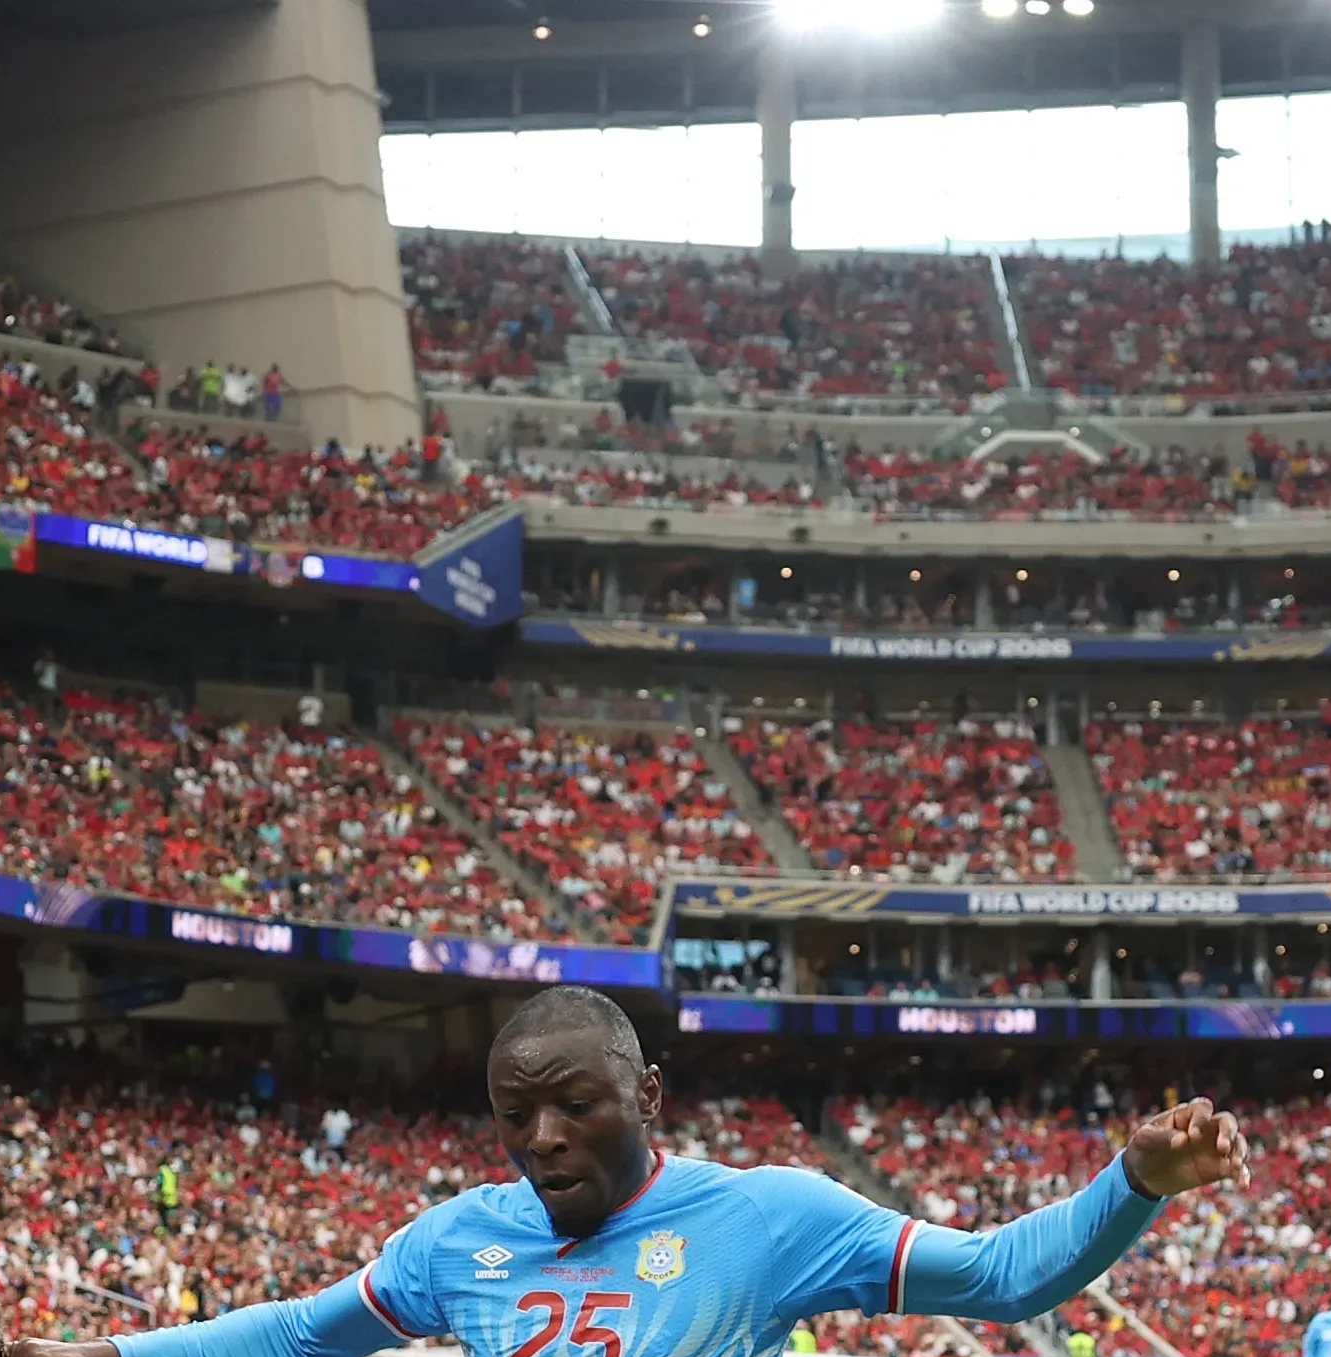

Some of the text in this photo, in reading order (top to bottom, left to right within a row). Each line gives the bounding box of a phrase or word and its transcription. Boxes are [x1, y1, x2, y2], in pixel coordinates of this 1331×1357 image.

[875, 638, 952, 658] WORLD
[969, 891, 1240, 914] FIFA WORLD CUP 2026
[172, 910, 293, 953] HOUSTON
[898, 1007, 1037, 1034] HOUSTON
[474, 1268, 510, 1280] umbro
[643, 1269, 676, 1281] FECOFA
